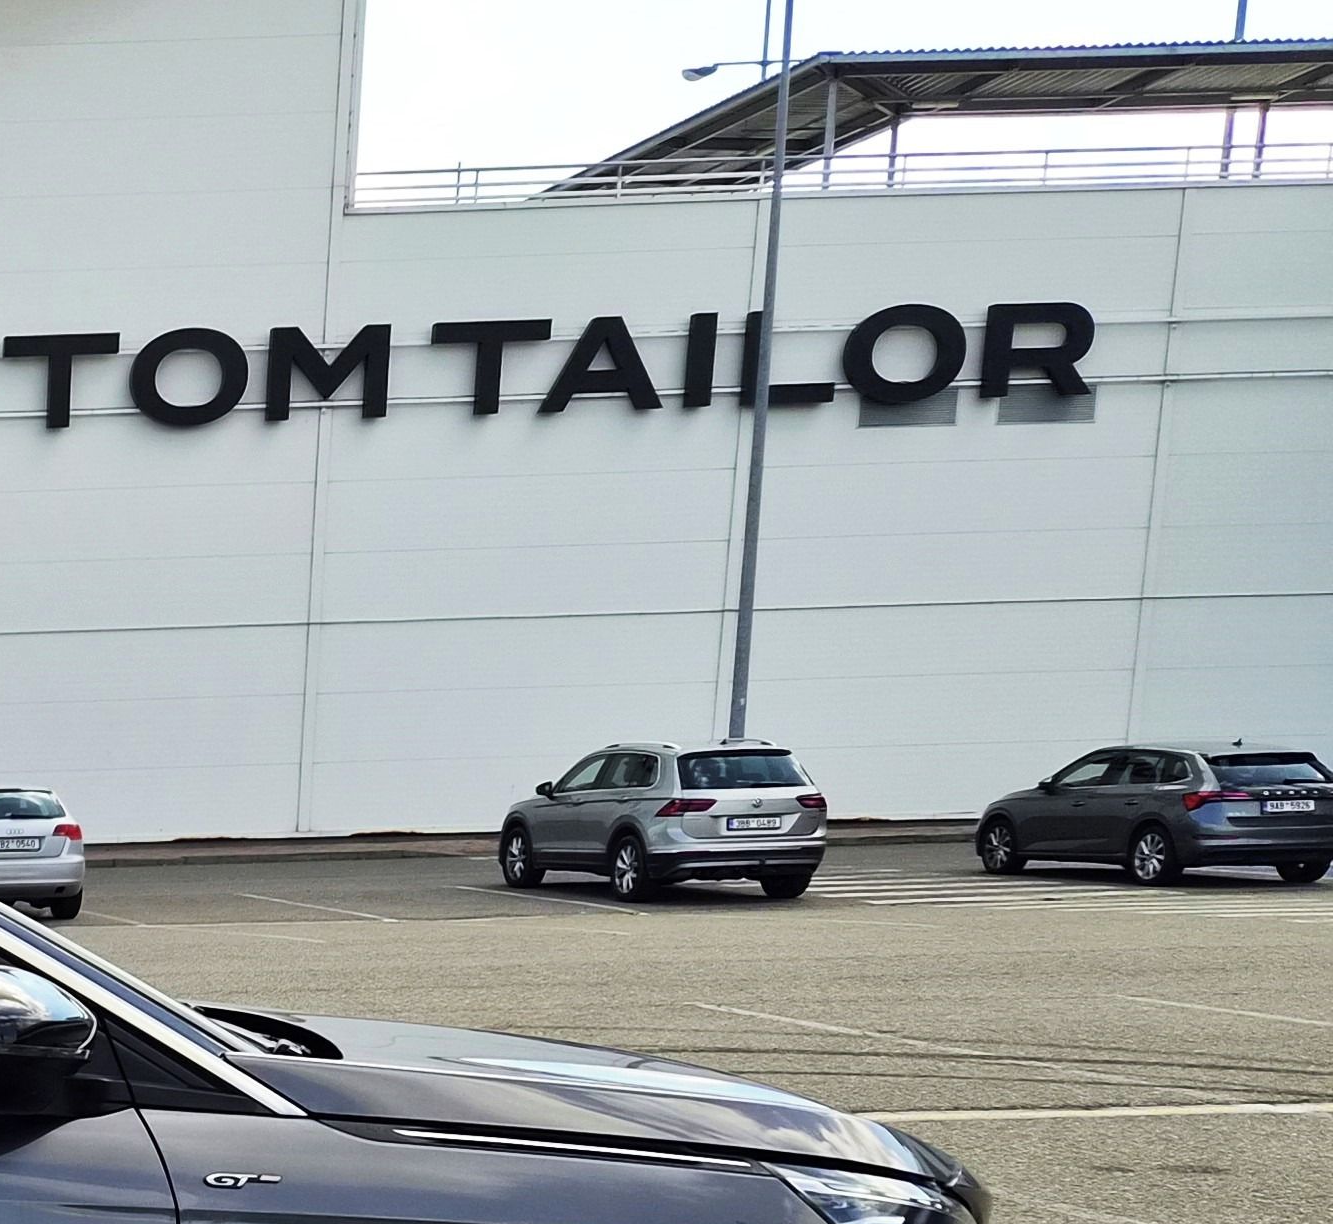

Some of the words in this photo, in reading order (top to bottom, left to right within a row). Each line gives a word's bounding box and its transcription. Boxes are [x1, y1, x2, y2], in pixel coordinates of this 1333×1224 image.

[2, 323, 392, 429] TOM
[431, 301, 1096, 415] TAILOR
[16, 840, 36, 849] 0540
[204, 1172, 259, 1188] GT
